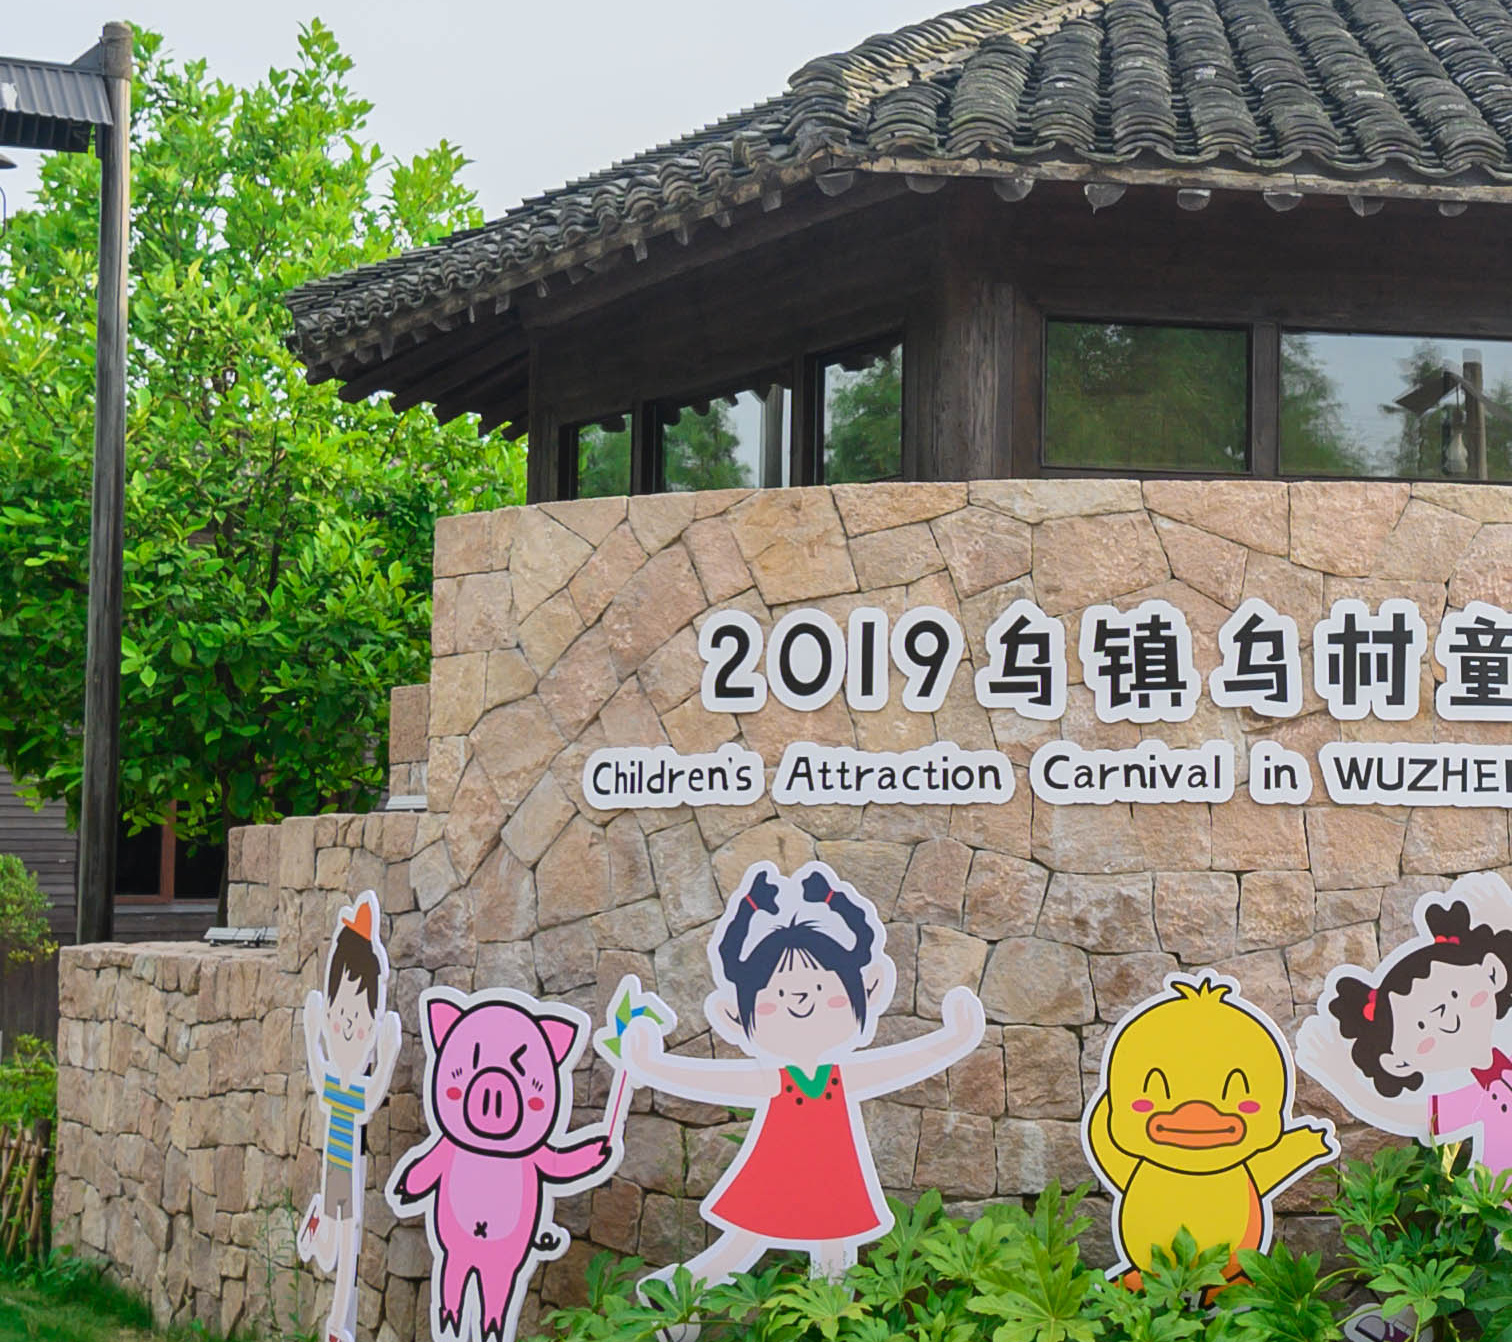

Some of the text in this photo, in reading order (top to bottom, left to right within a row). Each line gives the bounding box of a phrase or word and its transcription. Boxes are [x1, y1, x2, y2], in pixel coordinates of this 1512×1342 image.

[592, 756, 752, 796] Children's
[786, 755, 1003, 792] Attraction
[1042, 754, 1222, 790] Carnival
[1262, 754, 1299, 790] in
